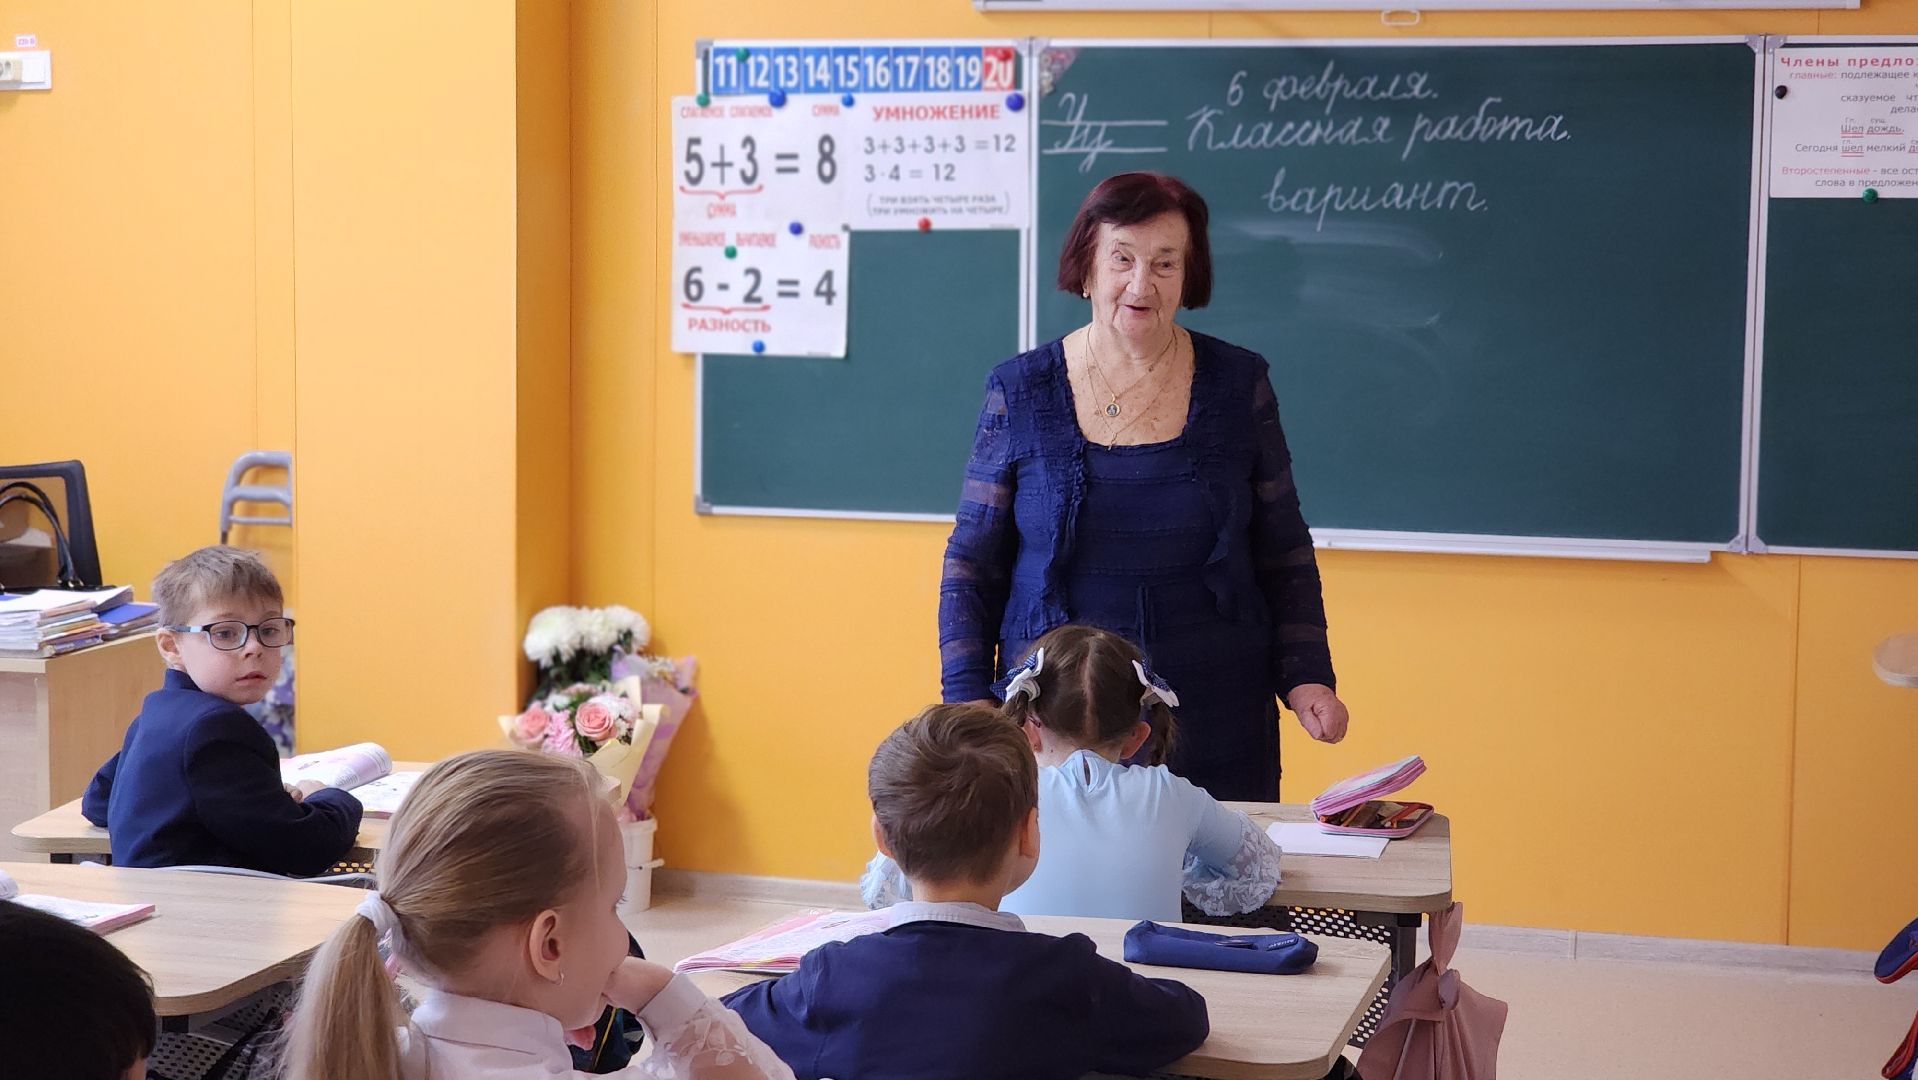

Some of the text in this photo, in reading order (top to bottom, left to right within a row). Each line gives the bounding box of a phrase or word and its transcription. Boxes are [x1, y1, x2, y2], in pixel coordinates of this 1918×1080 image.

[1780, 57, 1918, 69] Члены предло
[714, 55, 1014, 88] 11 12 13 14 15 16 17 18 19 20
[1790, 72, 1837, 80] главные:
[1841, 71, 1910, 80] подлежащее
[1226, 60, 1439, 116] 6 февраля.
[1841, 95, 1896, 103] сказуемое
[872, 104, 1000, 121] УМНОЖЕНИЕ
[1186, 97, 1572, 161] Классная работа.
[1841, 125, 1863, 133] Шел
[1795, 144, 1838, 153] Сегодня
[1866, 143, 1905, 152] мелкий
[817, 134, 837, 185] 8
[933, 163, 956, 182] 12
[1782, 167, 1870, 176] Второстепенные
[1815, 179, 1846, 187] слова
[1261, 165, 1489, 232] вариант.
[683, 266, 704, 303] 6
[742, 267, 763, 304] 2
[777, 279, 800, 298] =
[814, 269, 837, 306] 4
[687, 317, 772, 333] РАЗНОСТЬ
